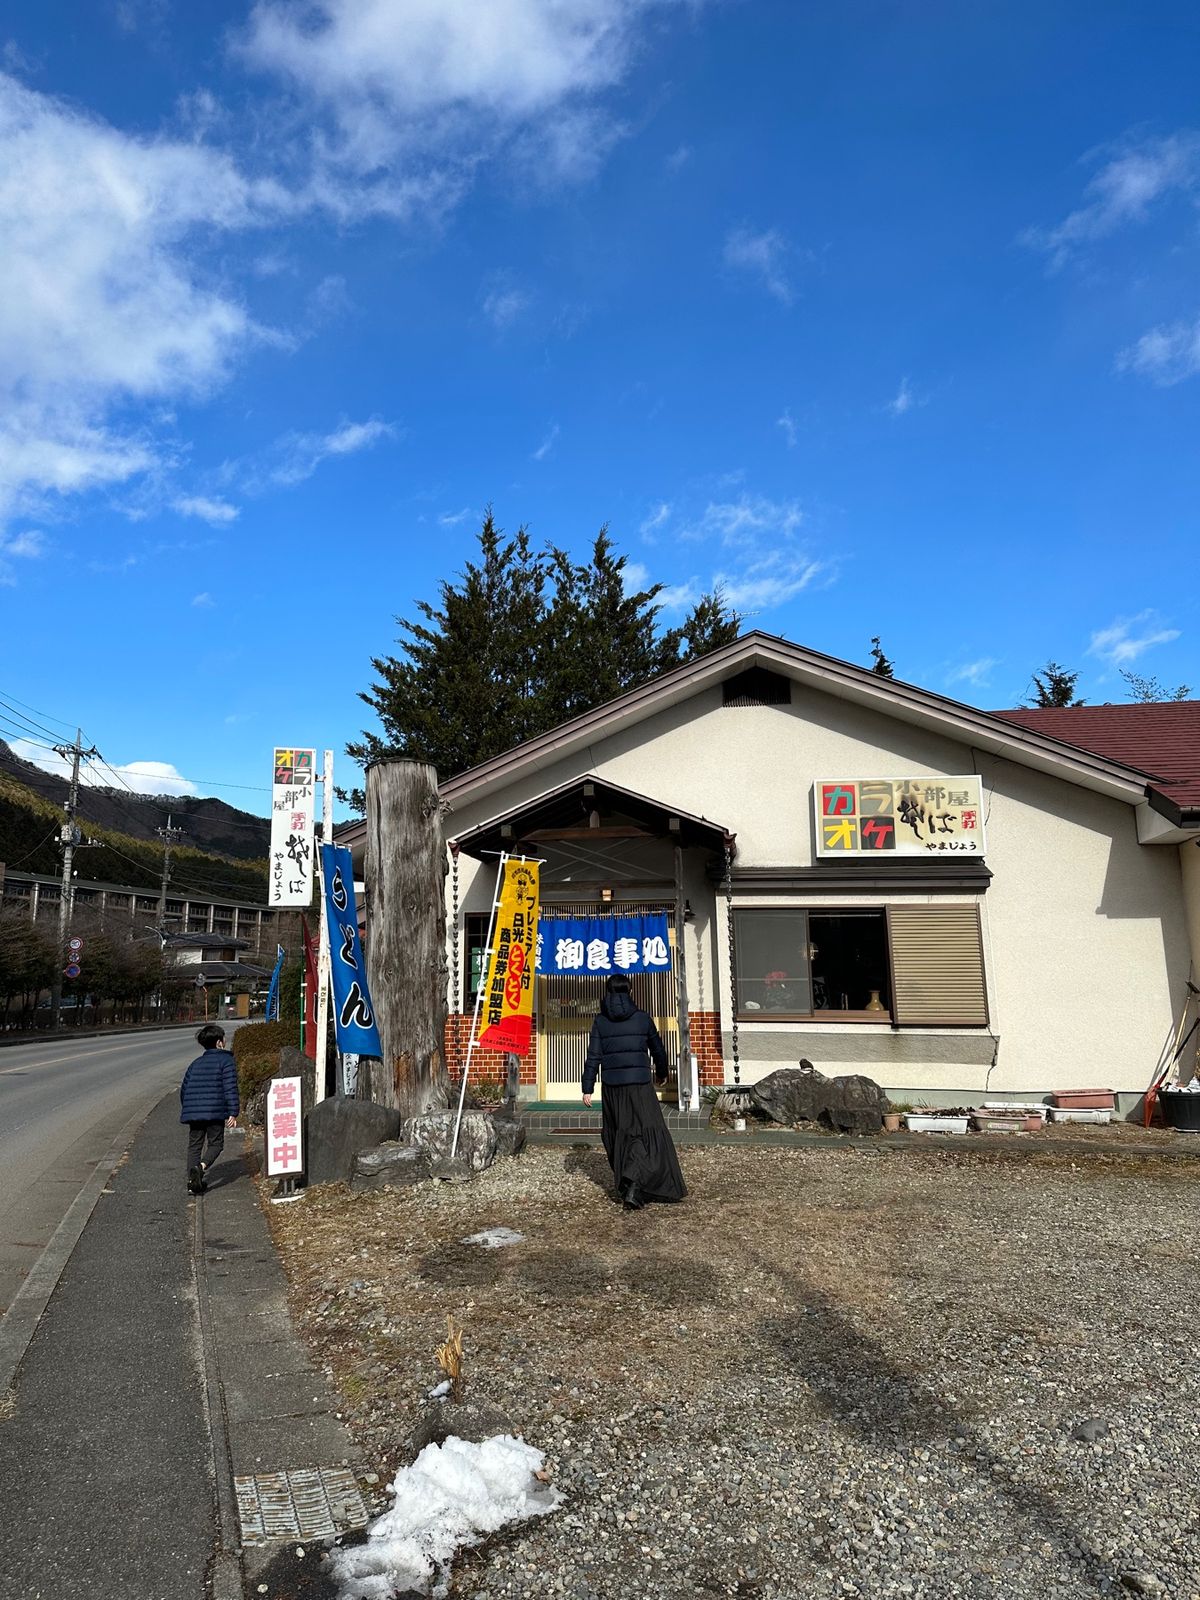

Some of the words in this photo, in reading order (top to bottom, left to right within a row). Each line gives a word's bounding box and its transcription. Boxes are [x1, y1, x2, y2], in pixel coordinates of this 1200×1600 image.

[274, 787, 312, 812] 小部屋
[896, 780, 977, 810] 小部屋
[961, 810, 977, 829] 手打
[925, 841, 977, 851] やまじょう
[273, 852, 284, 901] やまじょう
[332, 866, 374, 1029] うどん
[521, 895, 536, 990] プレミアム付
[555, 936, 668, 970] 御食事処
[488, 927, 511, 1026] 商品券加盟店
[272, 1083, 298, 1169] 営業中
